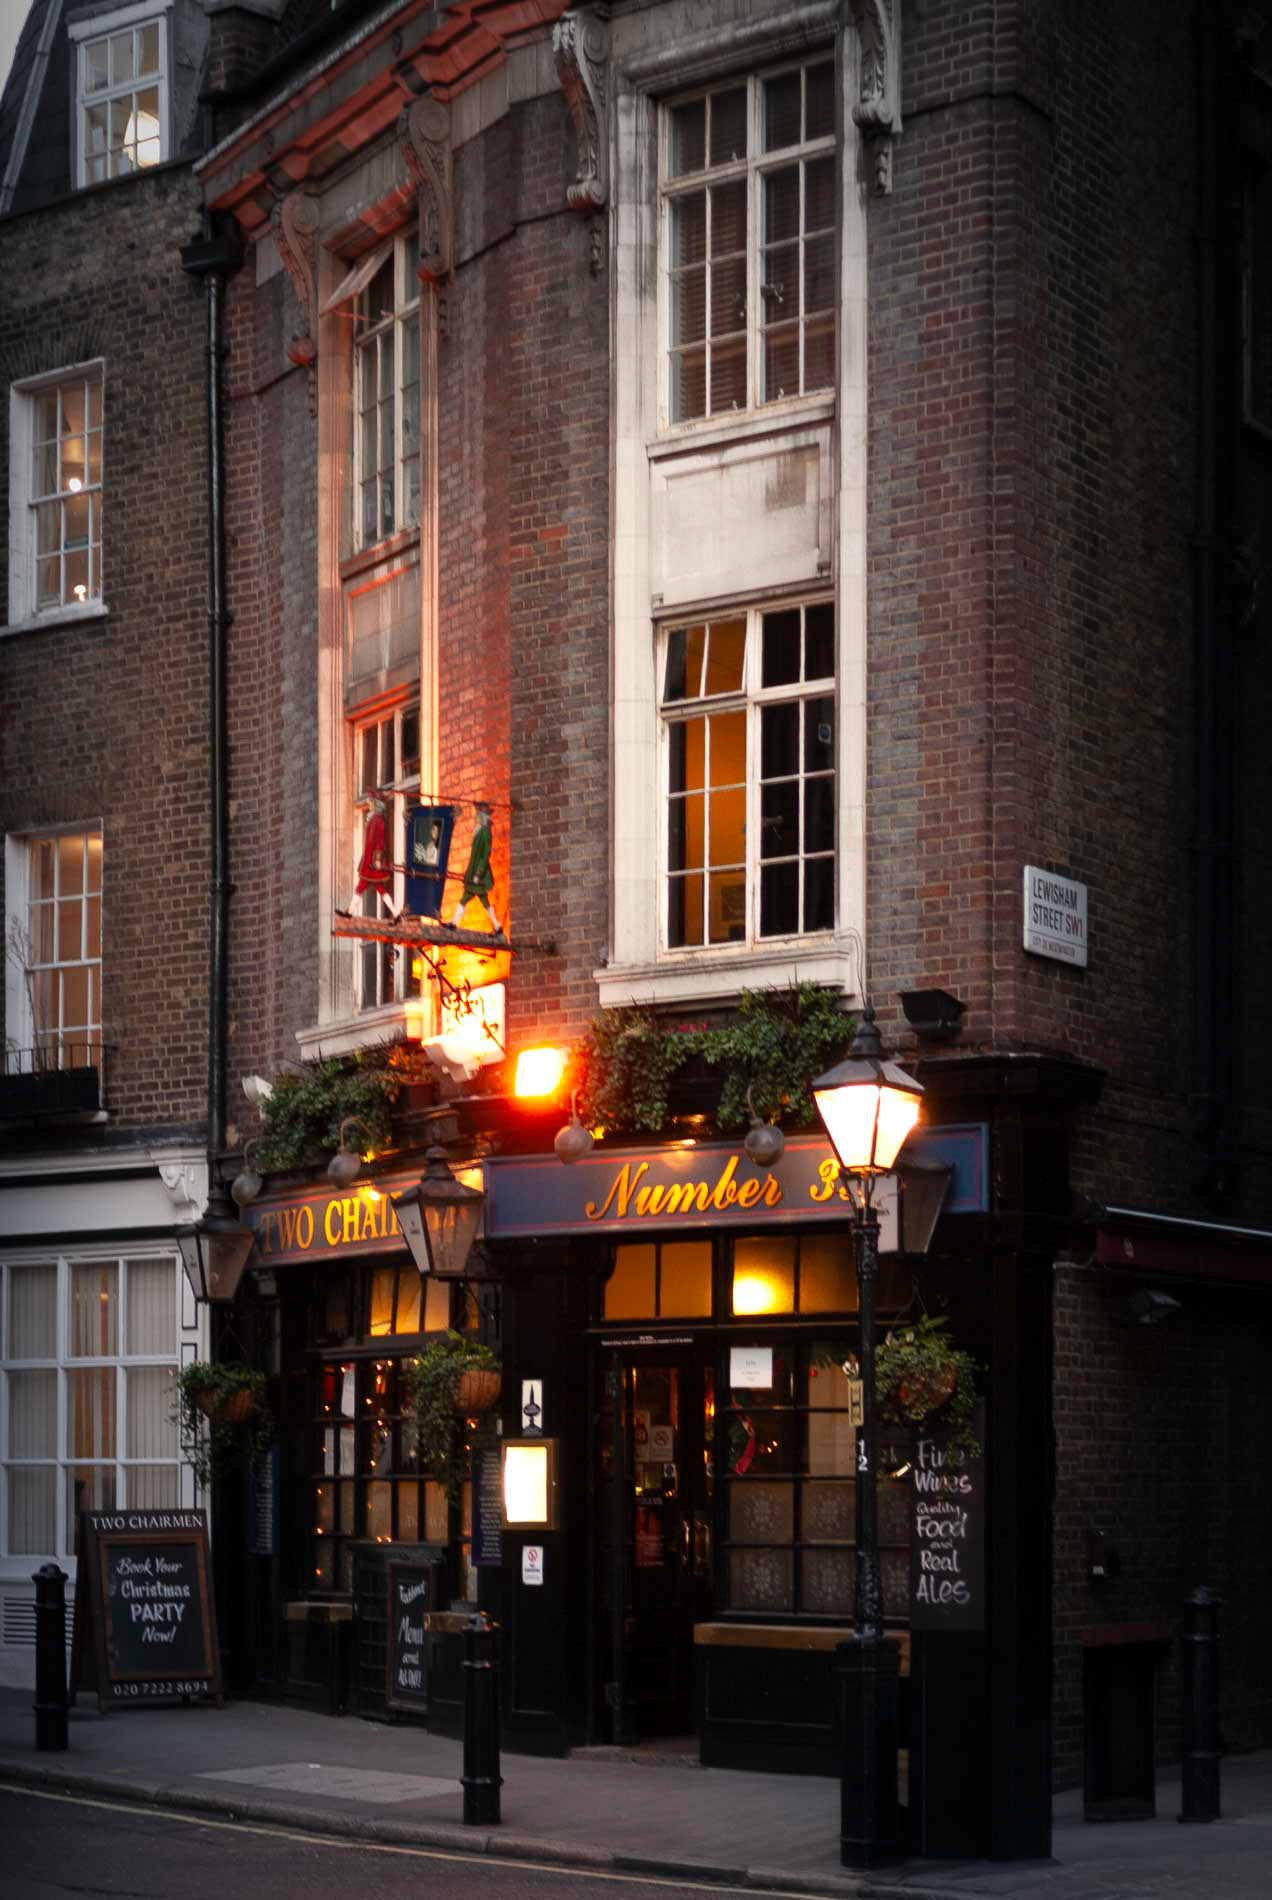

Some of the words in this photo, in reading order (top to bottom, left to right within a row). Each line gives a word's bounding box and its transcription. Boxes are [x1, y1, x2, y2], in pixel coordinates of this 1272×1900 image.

[1033, 876, 1078, 911] LEWISHAM
[1033, 903, 1063, 932] STREET
[1065, 913, 1083, 938] SW1
[586, 1156, 782, 1219] Number
[809, 1158, 851, 1203] 3
[262, 1206, 314, 1251] TWO
[92, 1516, 125, 1530] TWO
[129, 1514, 203, 1530] CHAIRMEN
[916, 1512, 968, 1538] Food
[116, 1557, 153, 1576] Book
[155, 1557, 183, 1574] Your
[920, 1550, 961, 1572] Real
[121, 1579, 191, 1599] Christmas
[915, 1574, 971, 1604] Ales
[130, 1602, 185, 1623] PARTY
[142, 1626, 177, 1643] Now!
[113, 1685, 138, 1696] 020
[142, 1682, 173, 1695] 7222
[177, 1680, 209, 1693] 8694
